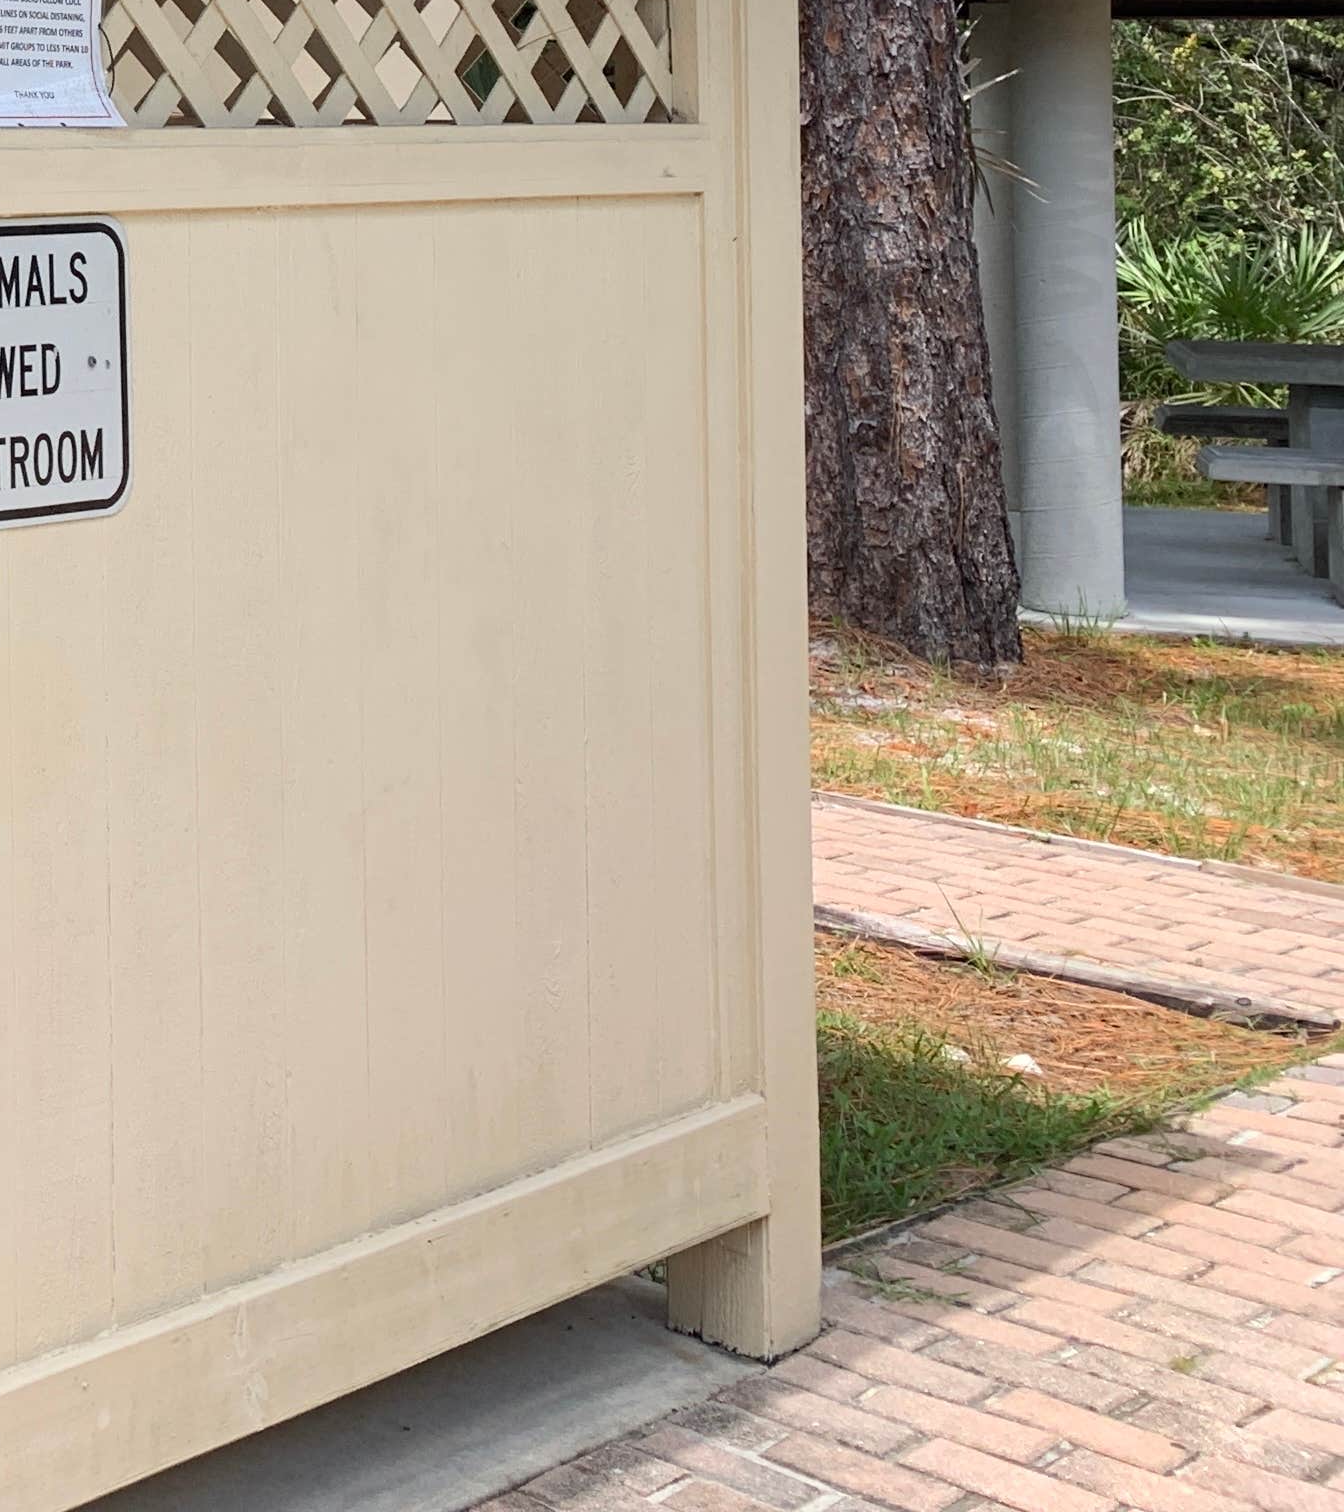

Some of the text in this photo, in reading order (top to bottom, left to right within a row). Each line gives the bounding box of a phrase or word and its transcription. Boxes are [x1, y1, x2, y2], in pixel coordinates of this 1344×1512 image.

[18, 9, 28, 19] ON
[28, 10, 49, 20] SOCIAL
[4, 25, 18, 35] FEET
[19, 26, 38, 36] APART
[38, 27, 57, 37] FROM
[58, 28, 83, 38] OTHERS
[10, 42, 35, 52] GROUPS
[36, 42, 46, 52] TO
[46, 43, 60, 53] LESS
[61, 44, 79, 54] THAN
[11, 58, 31, 68] AREAS
[31, 59, 41, 69] OF
[42, 59, 54, 69] THE
[14, 89, 39, 99] THANK
